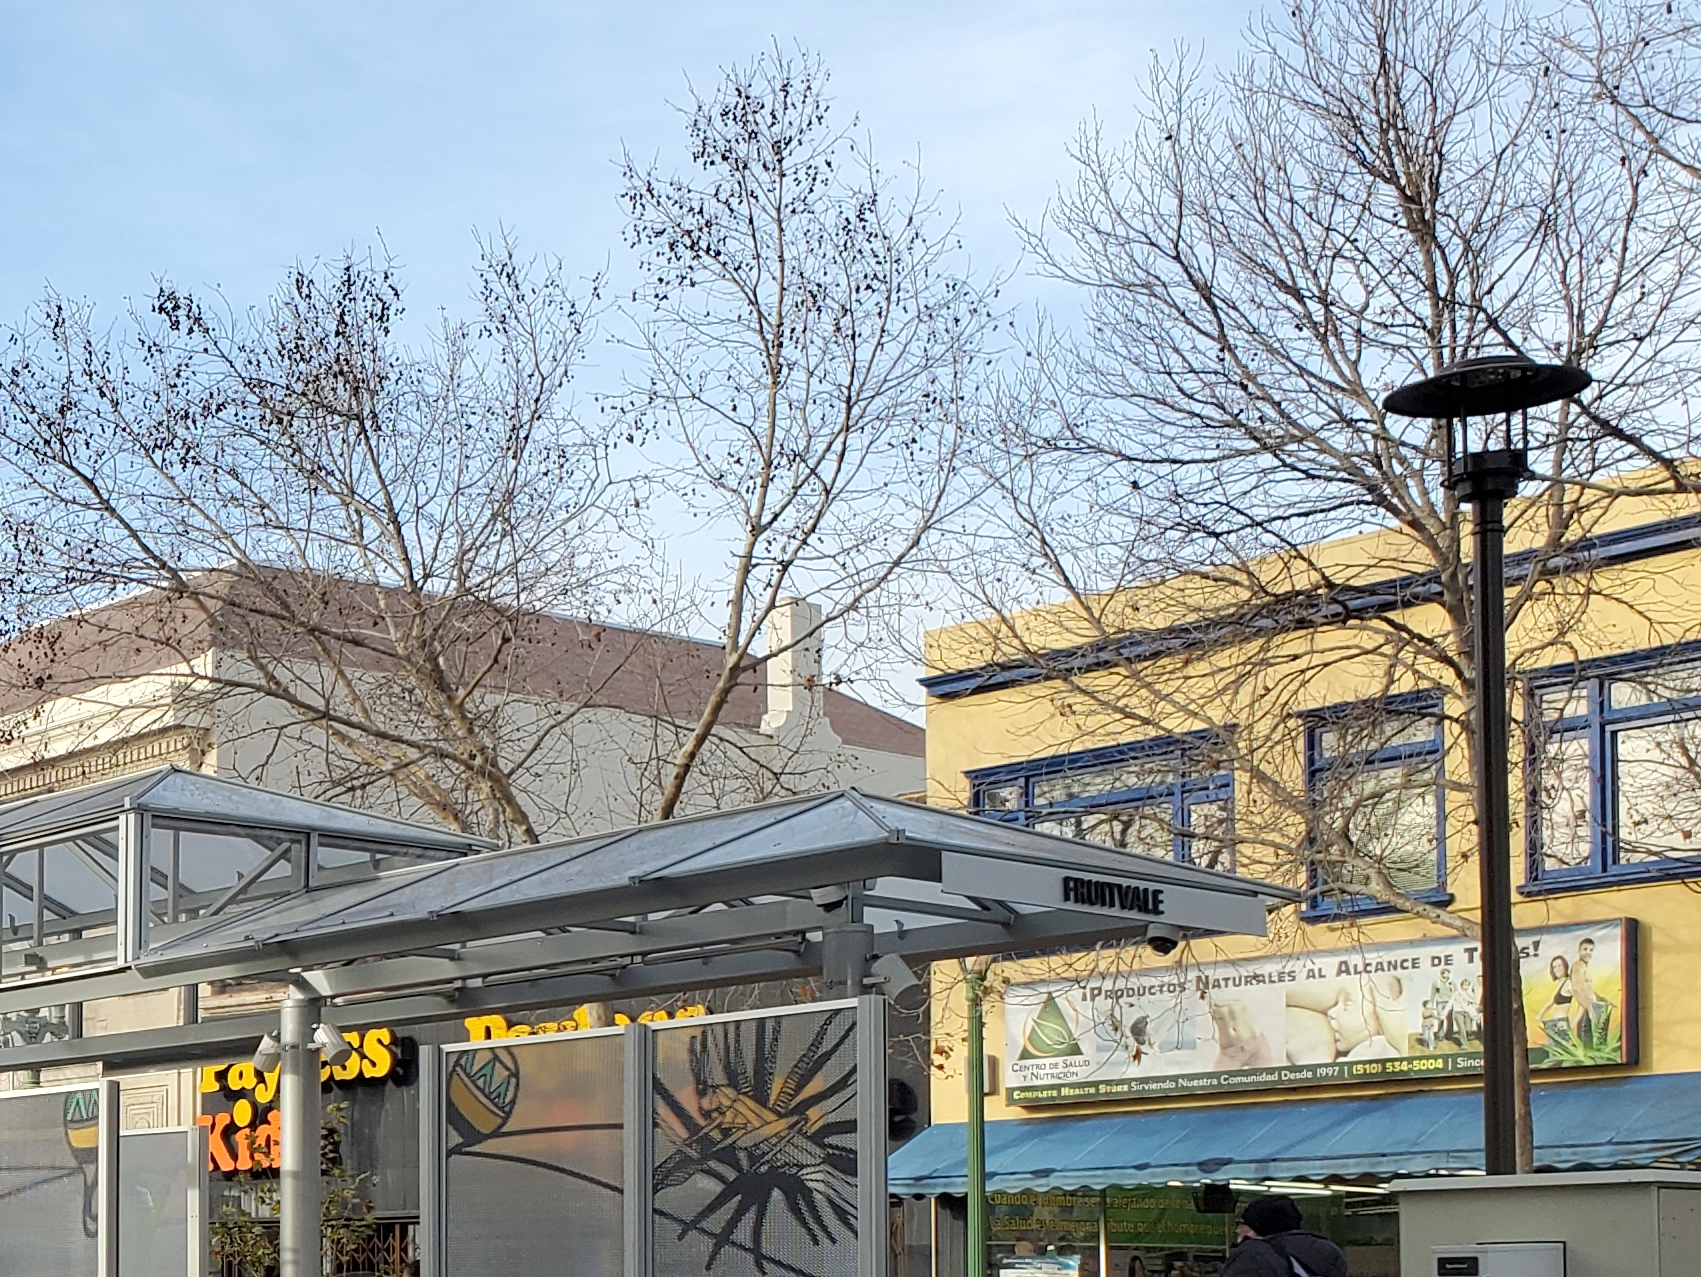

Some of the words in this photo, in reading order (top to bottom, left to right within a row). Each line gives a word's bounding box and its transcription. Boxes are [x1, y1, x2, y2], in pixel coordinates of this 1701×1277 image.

[1063, 875, 1165, 915] FRUITVALE
[1195, 970, 1296, 992] NATURALES
[1305, 965, 1326, 980] AL
[1335, 954, 1421, 977] ALCANCE
[1430, 953, 1454, 967] DE
[1011, 1063, 1047, 1073] CENTRO
[1048, 1062, 1059, 1070] DE
[1062, 1059, 1091, 1068] SALUD
[1012, 1089, 1059, 1100] COMPLETE
[1060, 1086, 1096, 1097] HEALTH
[1098, 1083, 1129, 1093] STORE
[1130, 1080, 1176, 1092] Sirviendo
[1178, 1077, 1218, 1088] Nuestra
[1220, 1071, 1279, 1085] Comunidad
[1281, 1069, 1313, 1080] Desde
[1316, 1066, 1339, 1077] 1997
[1352, 1062, 1383, 1076] (510)
[1030, 1069, 1079, 1081] NUTRICIÓN
